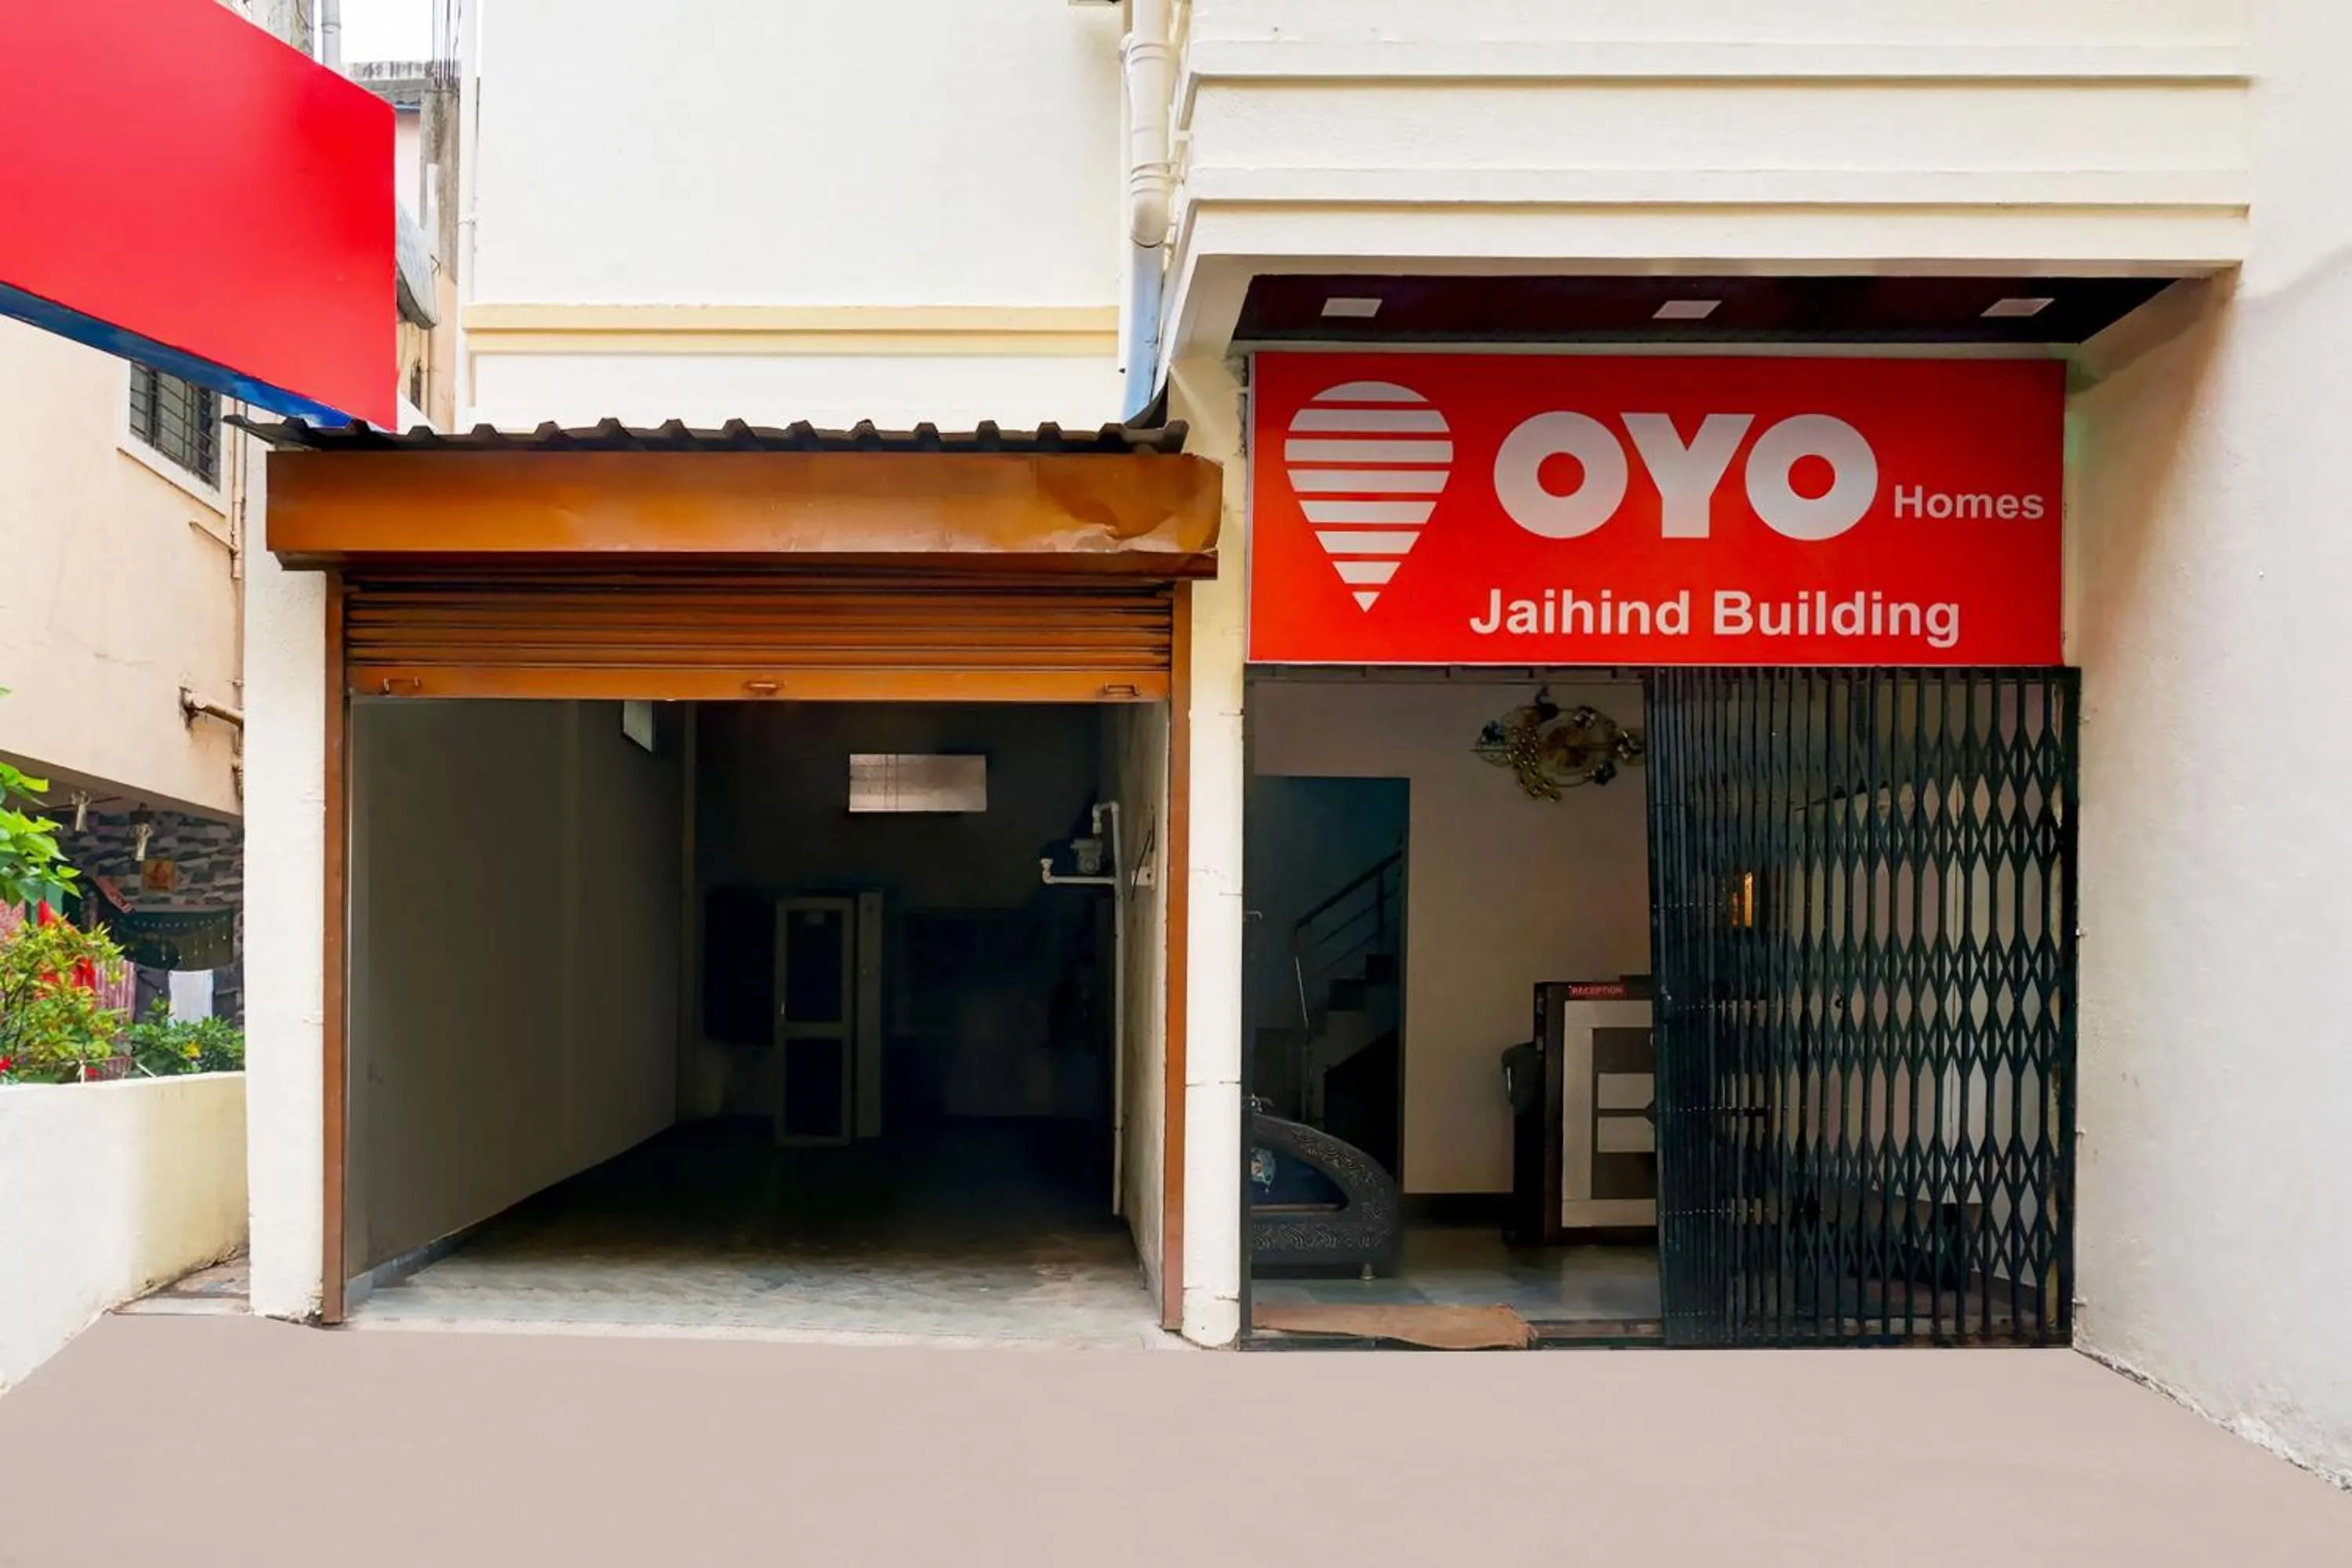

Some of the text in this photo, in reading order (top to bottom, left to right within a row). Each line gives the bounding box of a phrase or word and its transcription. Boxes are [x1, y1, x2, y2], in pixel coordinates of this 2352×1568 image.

[1494, 411, 2045, 542] OYO Homes
[1469, 589, 1960, 648] Jaihind Building
[1571, 985, 1624, 996] RECEPTION
